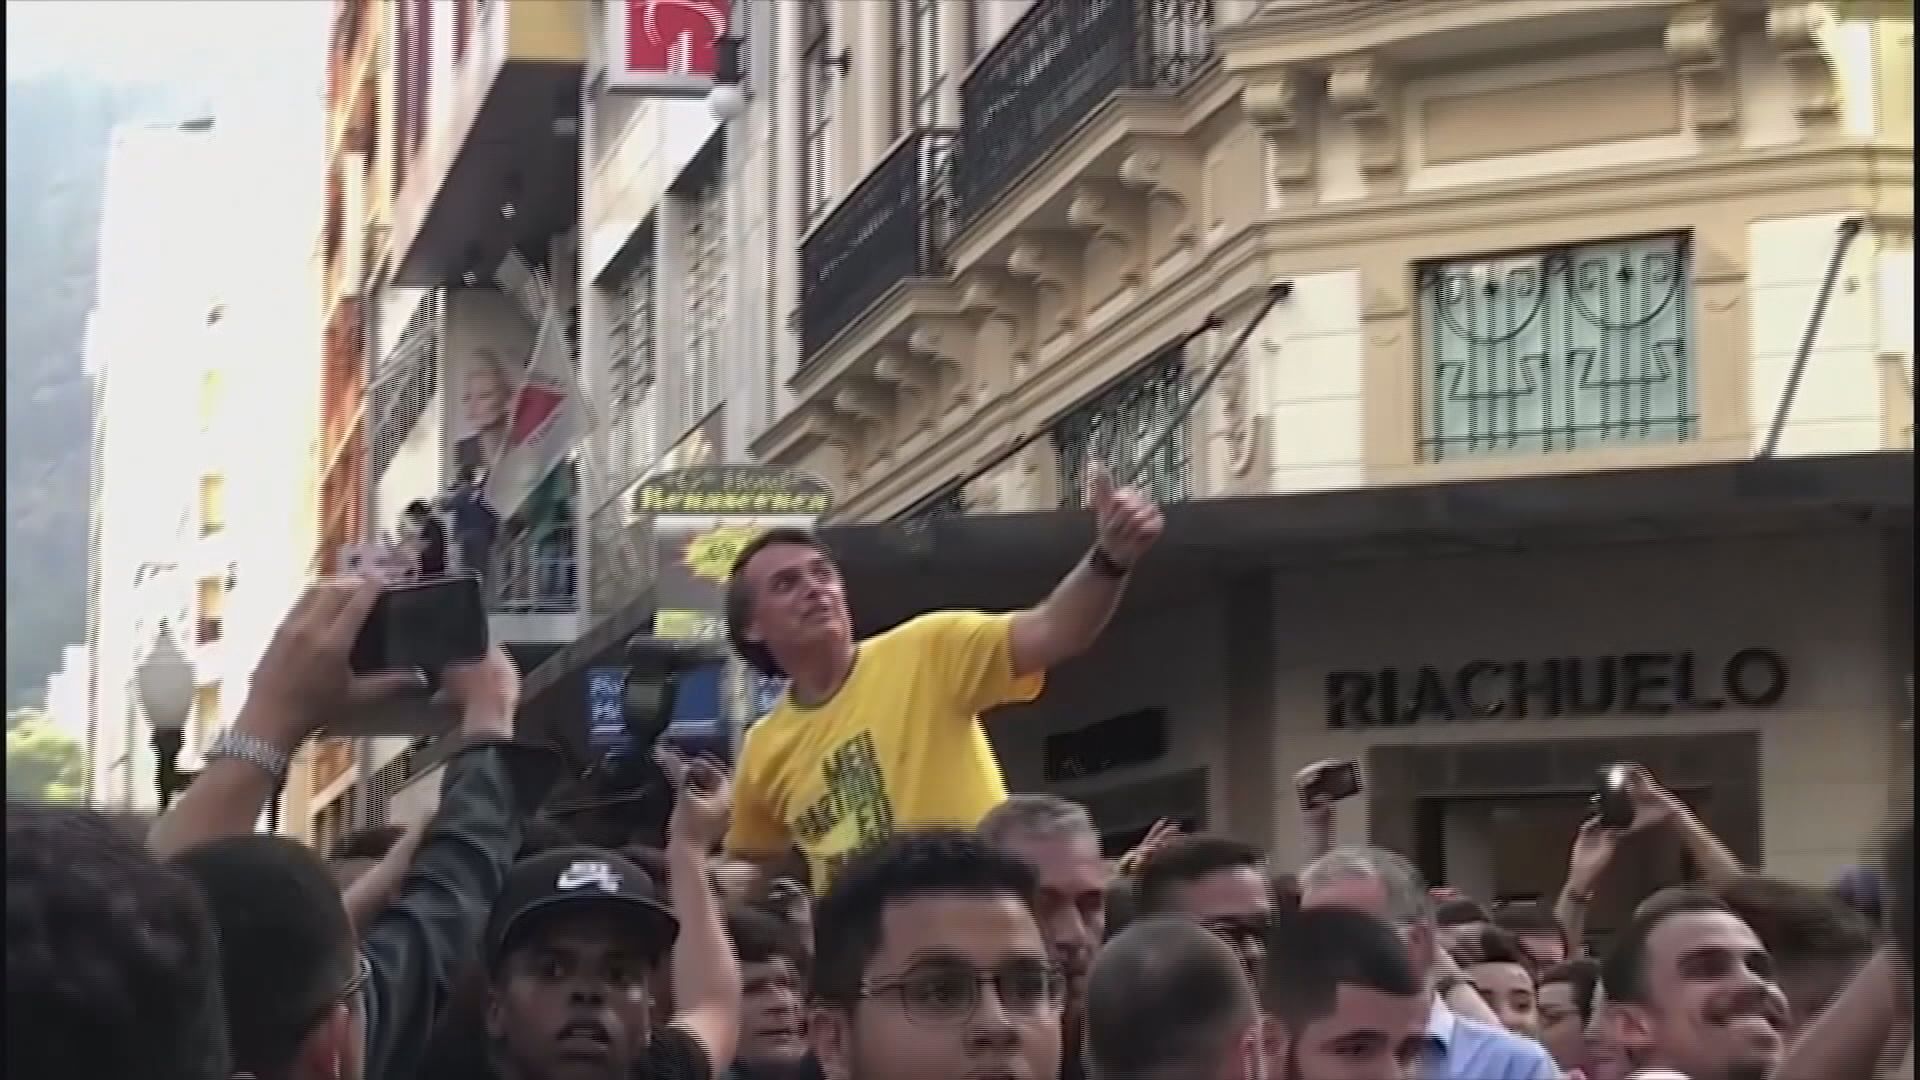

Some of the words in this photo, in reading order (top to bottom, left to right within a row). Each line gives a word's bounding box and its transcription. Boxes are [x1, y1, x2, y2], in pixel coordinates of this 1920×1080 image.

[722, 470, 795, 490] Hotel
[1325, 646, 1791, 729] RIACHUELO
[822, 728, 878, 790] MEU
[794, 761, 889, 838] PARTIDO
